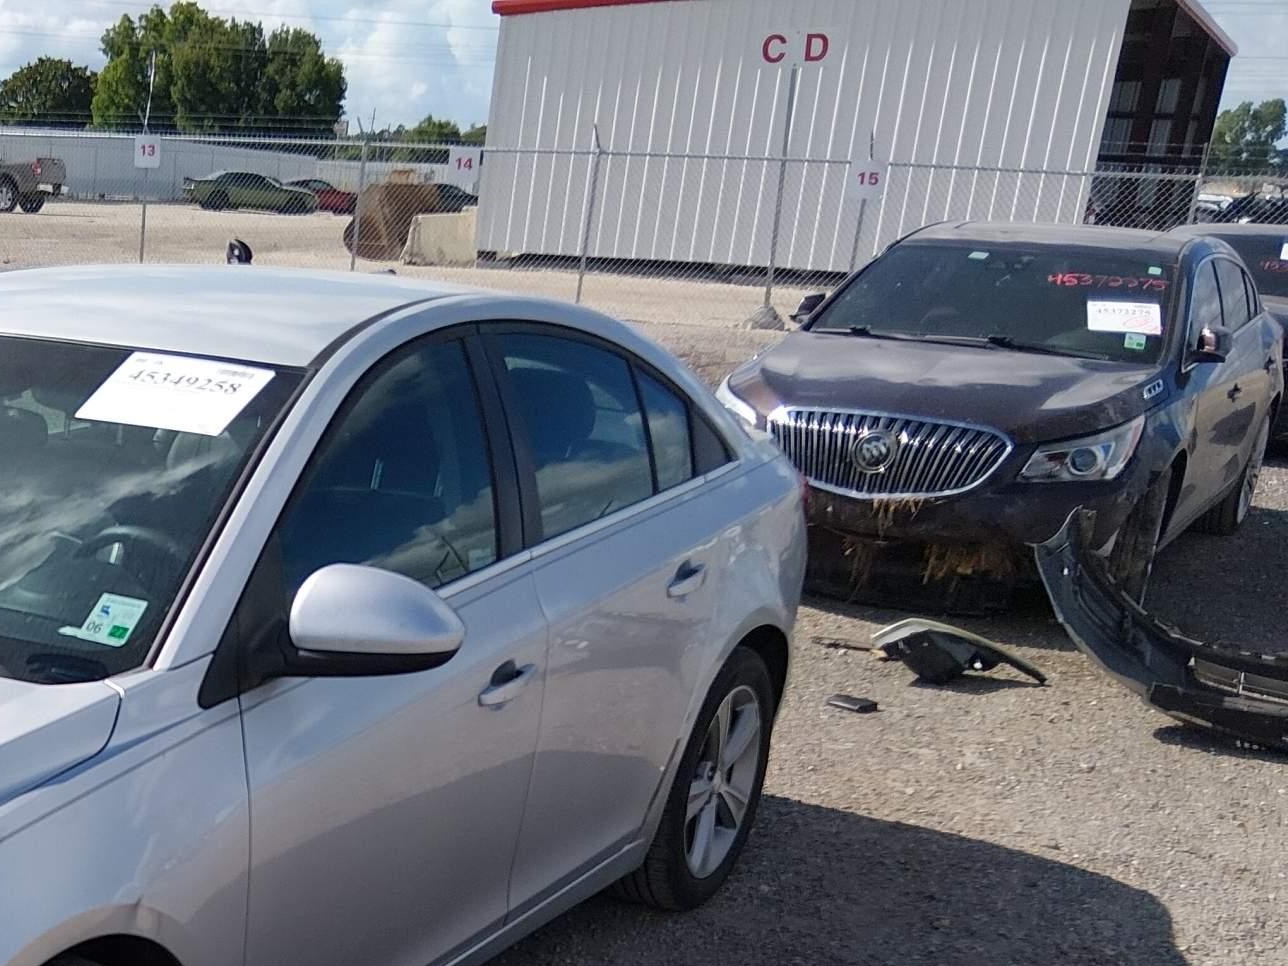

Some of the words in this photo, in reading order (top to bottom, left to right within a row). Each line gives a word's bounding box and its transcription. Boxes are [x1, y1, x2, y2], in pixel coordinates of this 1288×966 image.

[762, 34, 788, 63] C
[804, 33, 829, 62] D
[141, 143, 156, 157] 13
[456, 157, 473, 170] 14
[857, 172, 880, 185] 15
[128, 369, 243, 395] 45349258
[86, 621, 103, 634] 06
